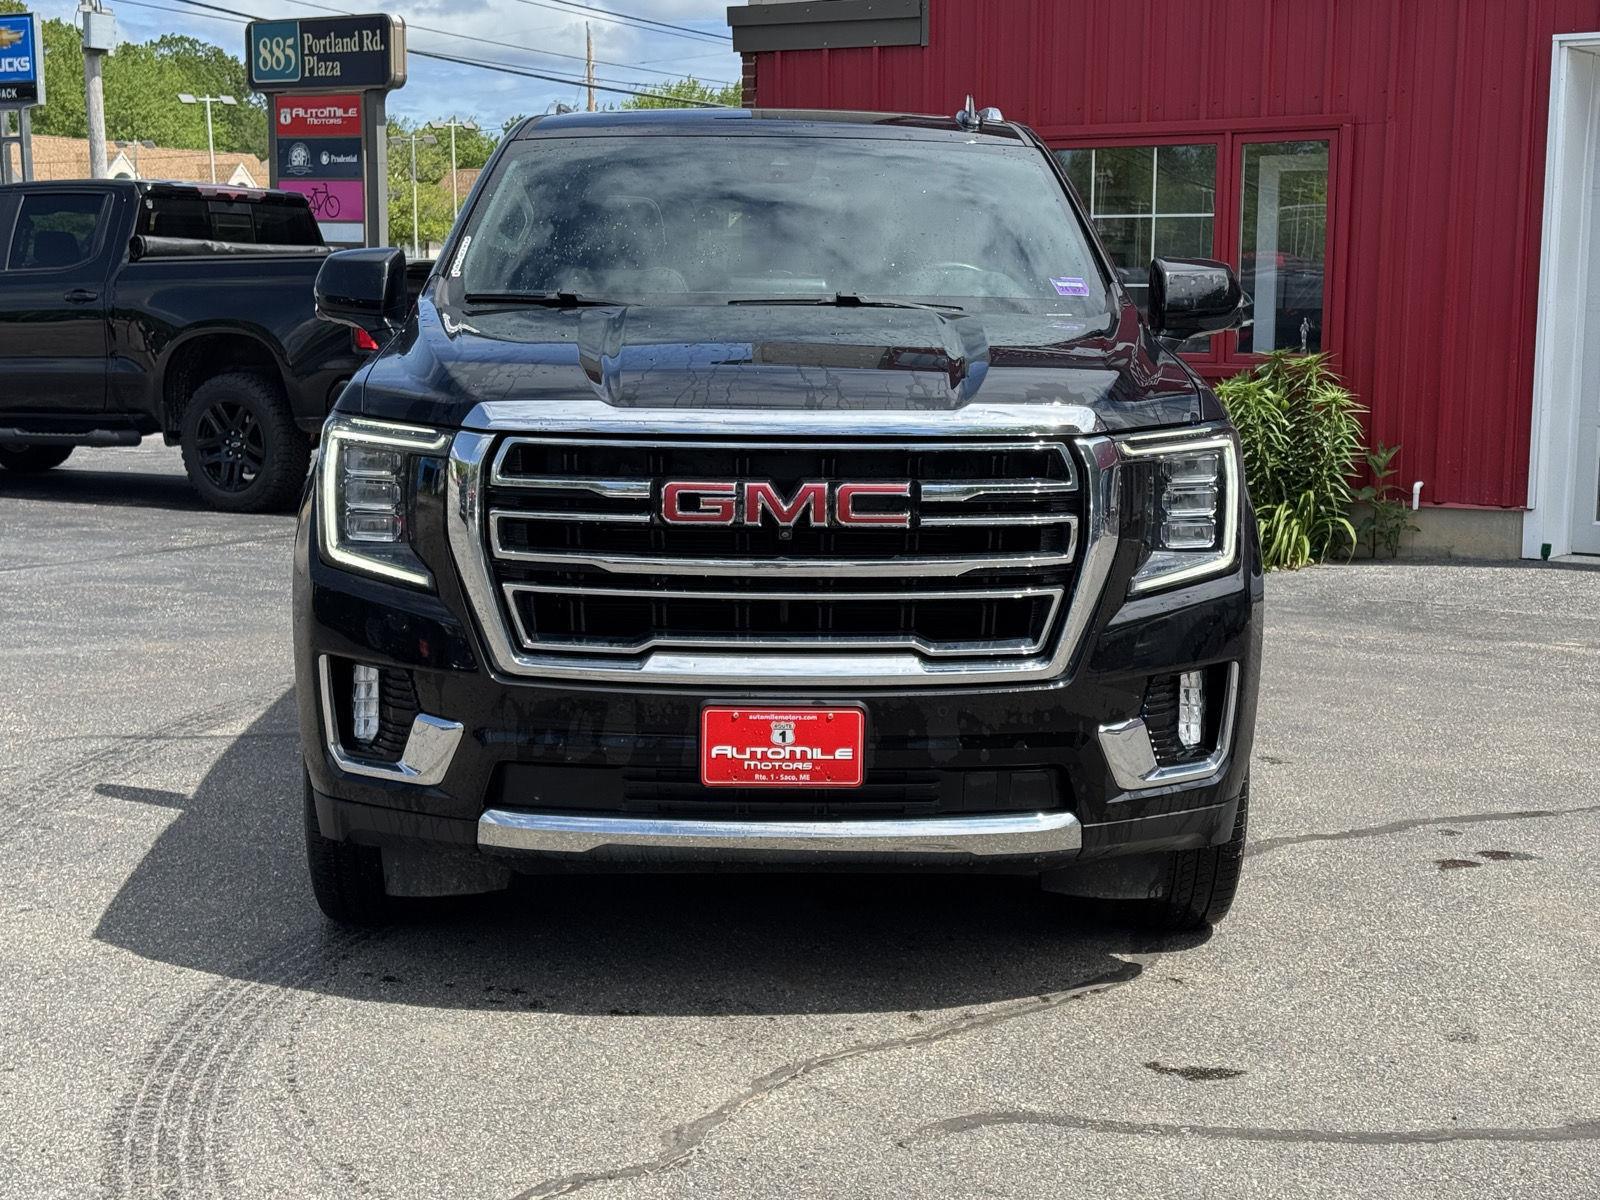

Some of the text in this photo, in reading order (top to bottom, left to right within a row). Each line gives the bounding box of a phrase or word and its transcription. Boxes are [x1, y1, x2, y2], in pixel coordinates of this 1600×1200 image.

[303, 29, 385, 54] Portland Rd.
[258, 37, 296, 73] 885
[304, 56, 341, 77] Plaza
[0, 88, 18, 99] ACK
[330, 154, 358, 163] Prudential
[661, 481, 911, 528] GMC
[779, 730, 787, 743] 1
[780, 773, 798, 781] Saco,
